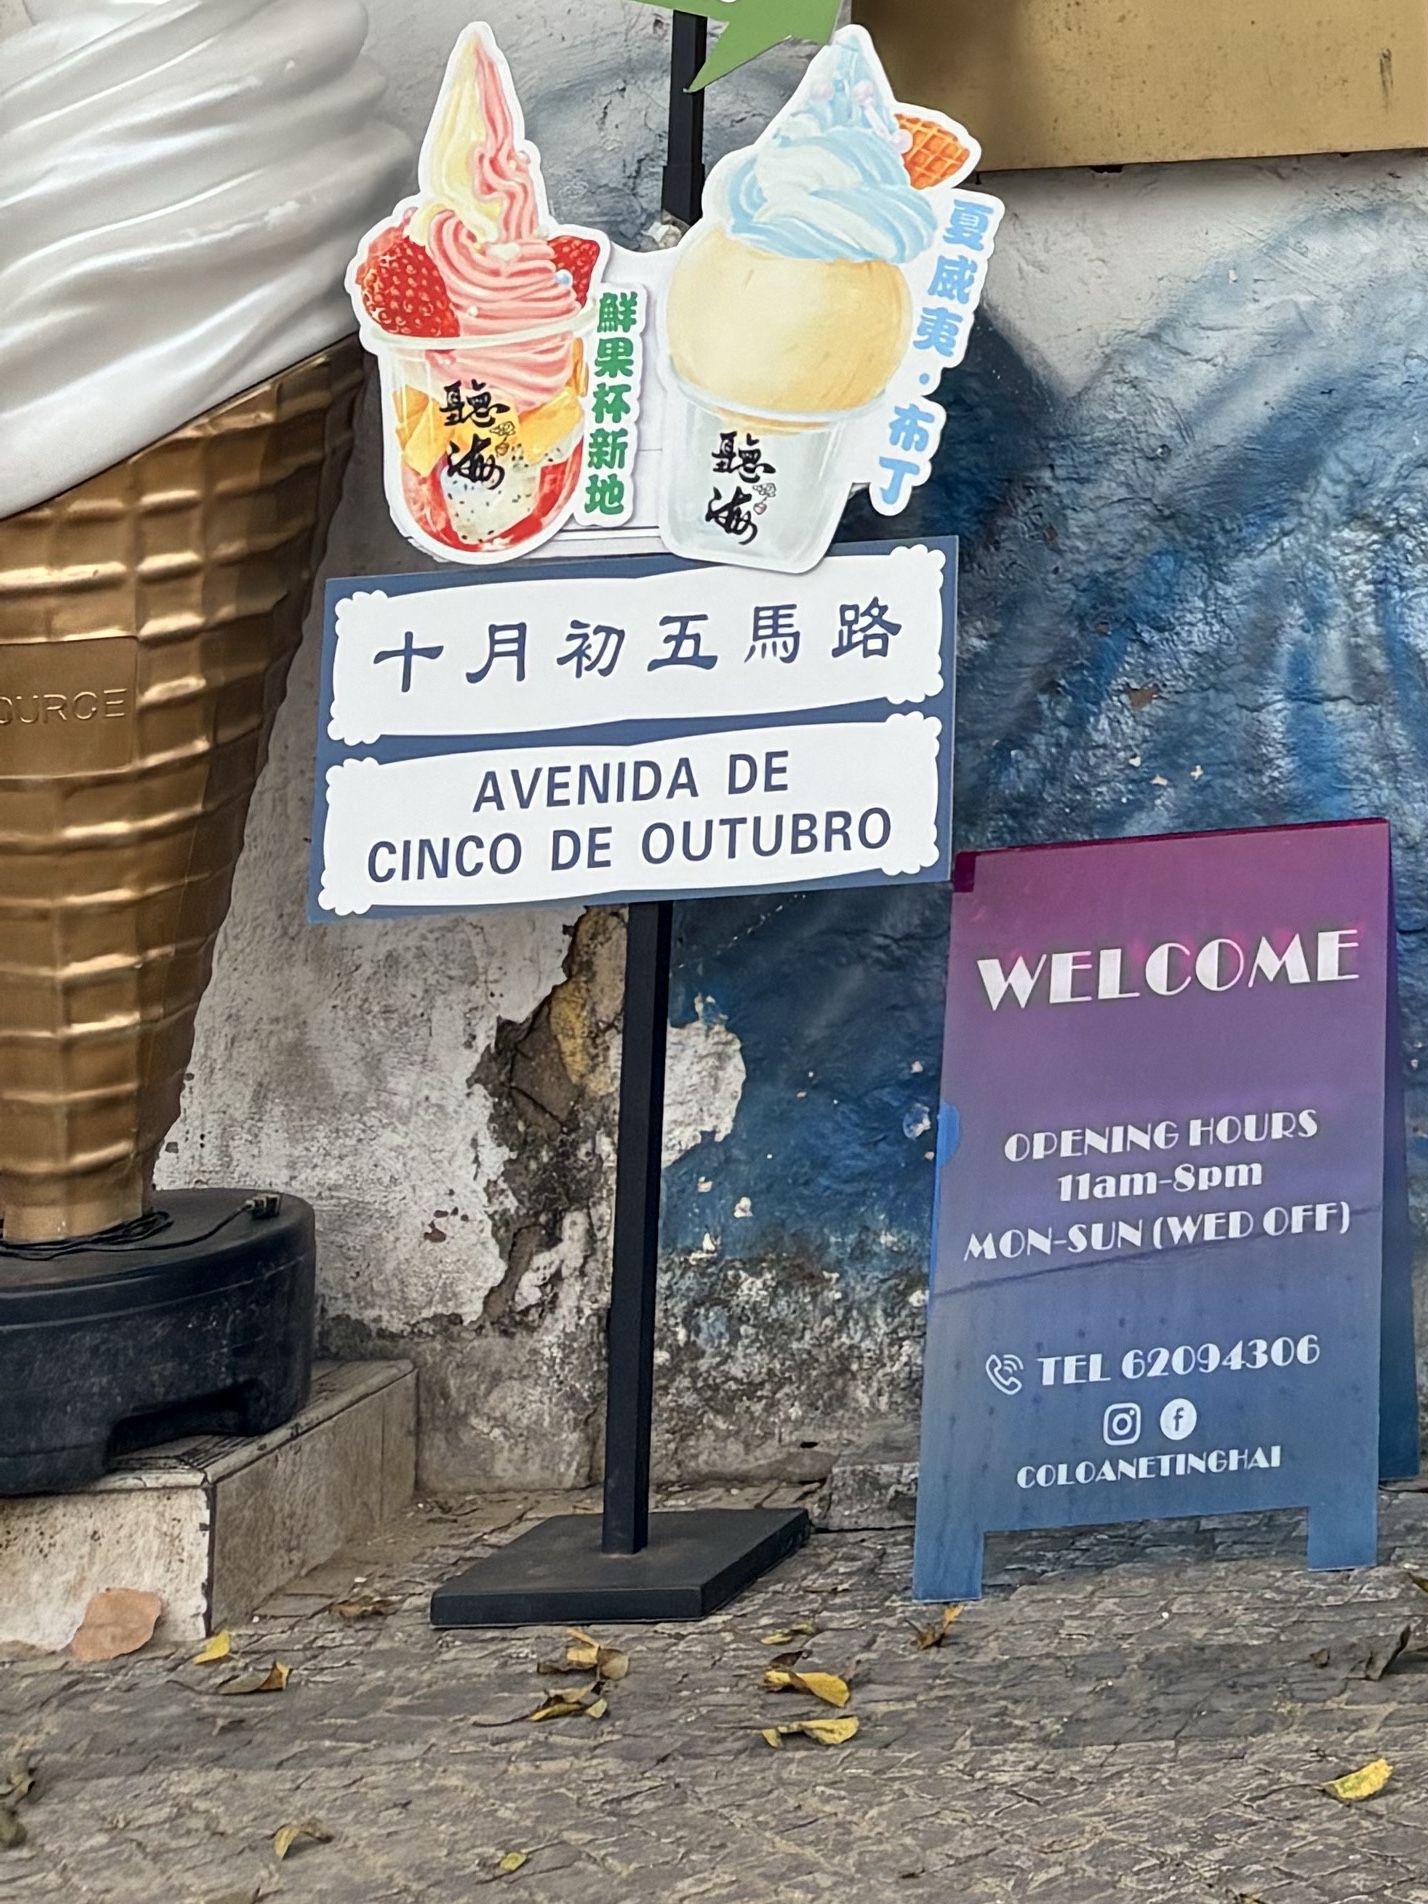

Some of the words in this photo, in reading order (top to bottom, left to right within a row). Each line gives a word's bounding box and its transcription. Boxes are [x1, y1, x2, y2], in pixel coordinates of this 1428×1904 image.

[584, 291, 638, 516] 鮮果杯新地
[372, 595, 903, 693] 十月初五馬路
[472, 755, 700, 813] AVENIDA
[726, 750, 789, 795] DE
[366, 831, 523, 884] CINCO
[549, 825, 613, 872] DE
[640, 806, 893, 866] OUTUBRO
[976, 929, 1360, 1012] WELCOME
[1003, 1120, 1180, 1163] OPENING
[1188, 1109, 1318, 1148] HOURS
[1057, 1162, 1263, 1202] 11am-8pm
[963, 1221, 1143, 1262] MON-SUN
[1152, 1208, 1254, 1250] (WED
[1262, 1201, 1351, 1238] OFF)
[1036, 1352, 1111, 1387] TEL
[1121, 1333, 1321, 1380] 62094306
[1015, 1444, 1282, 1489] COLOANETINGHAI
